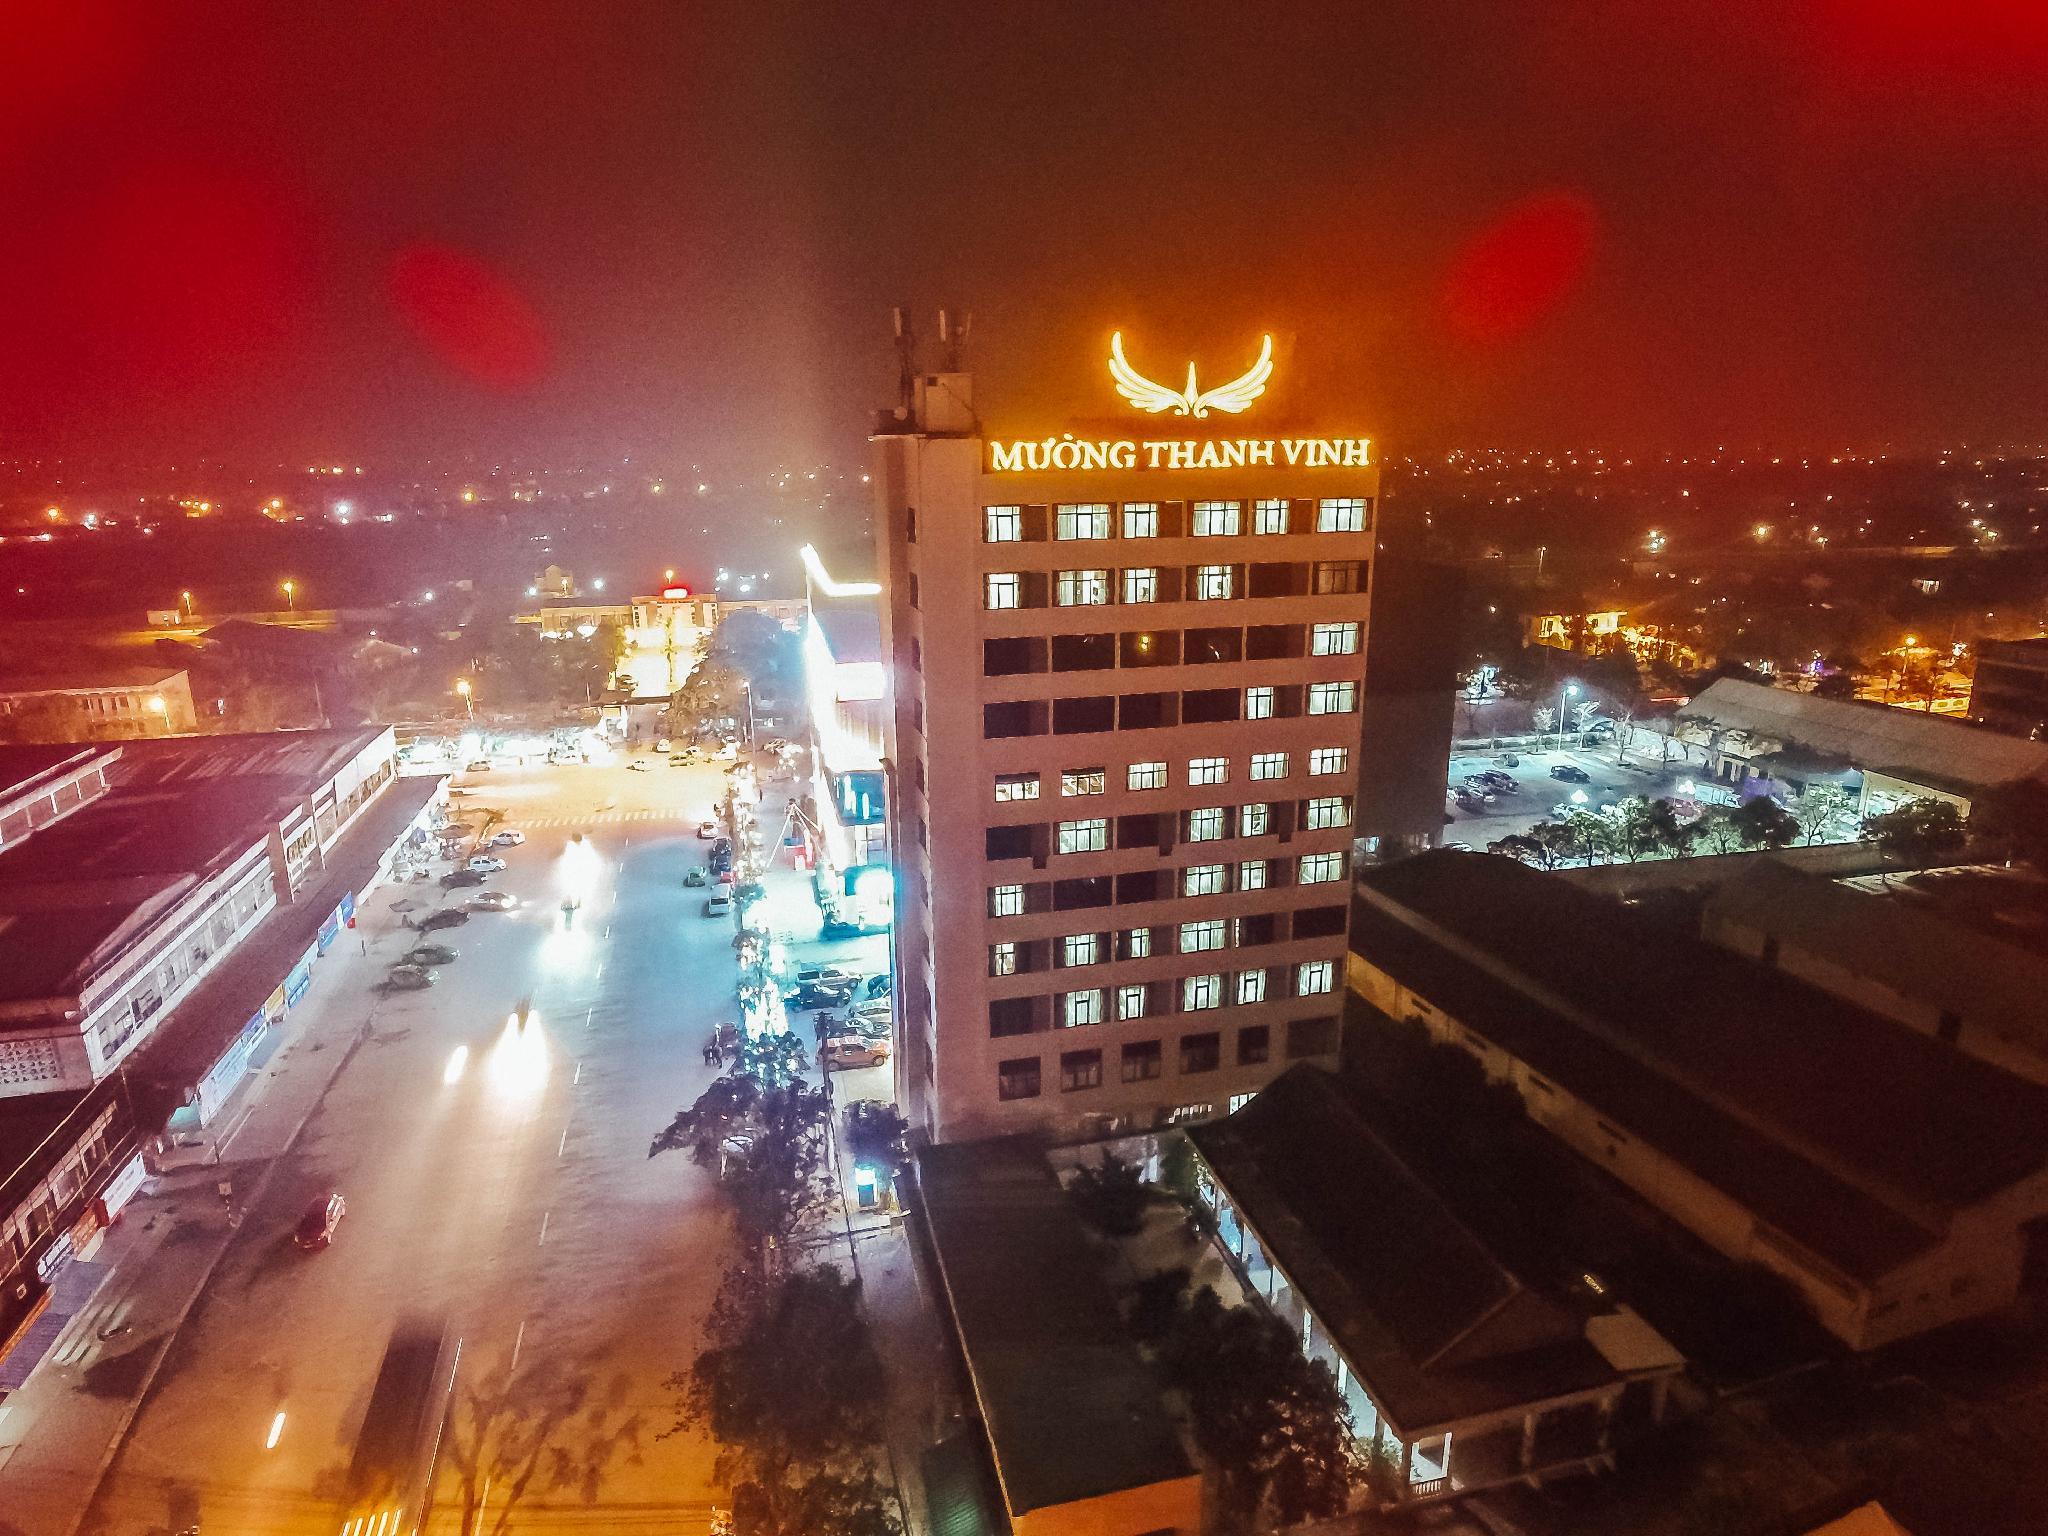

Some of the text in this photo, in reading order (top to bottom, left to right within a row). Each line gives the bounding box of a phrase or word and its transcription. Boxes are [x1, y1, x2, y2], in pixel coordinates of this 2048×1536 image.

[990, 433, 1373, 471] MƯỜNG THANH VINH
